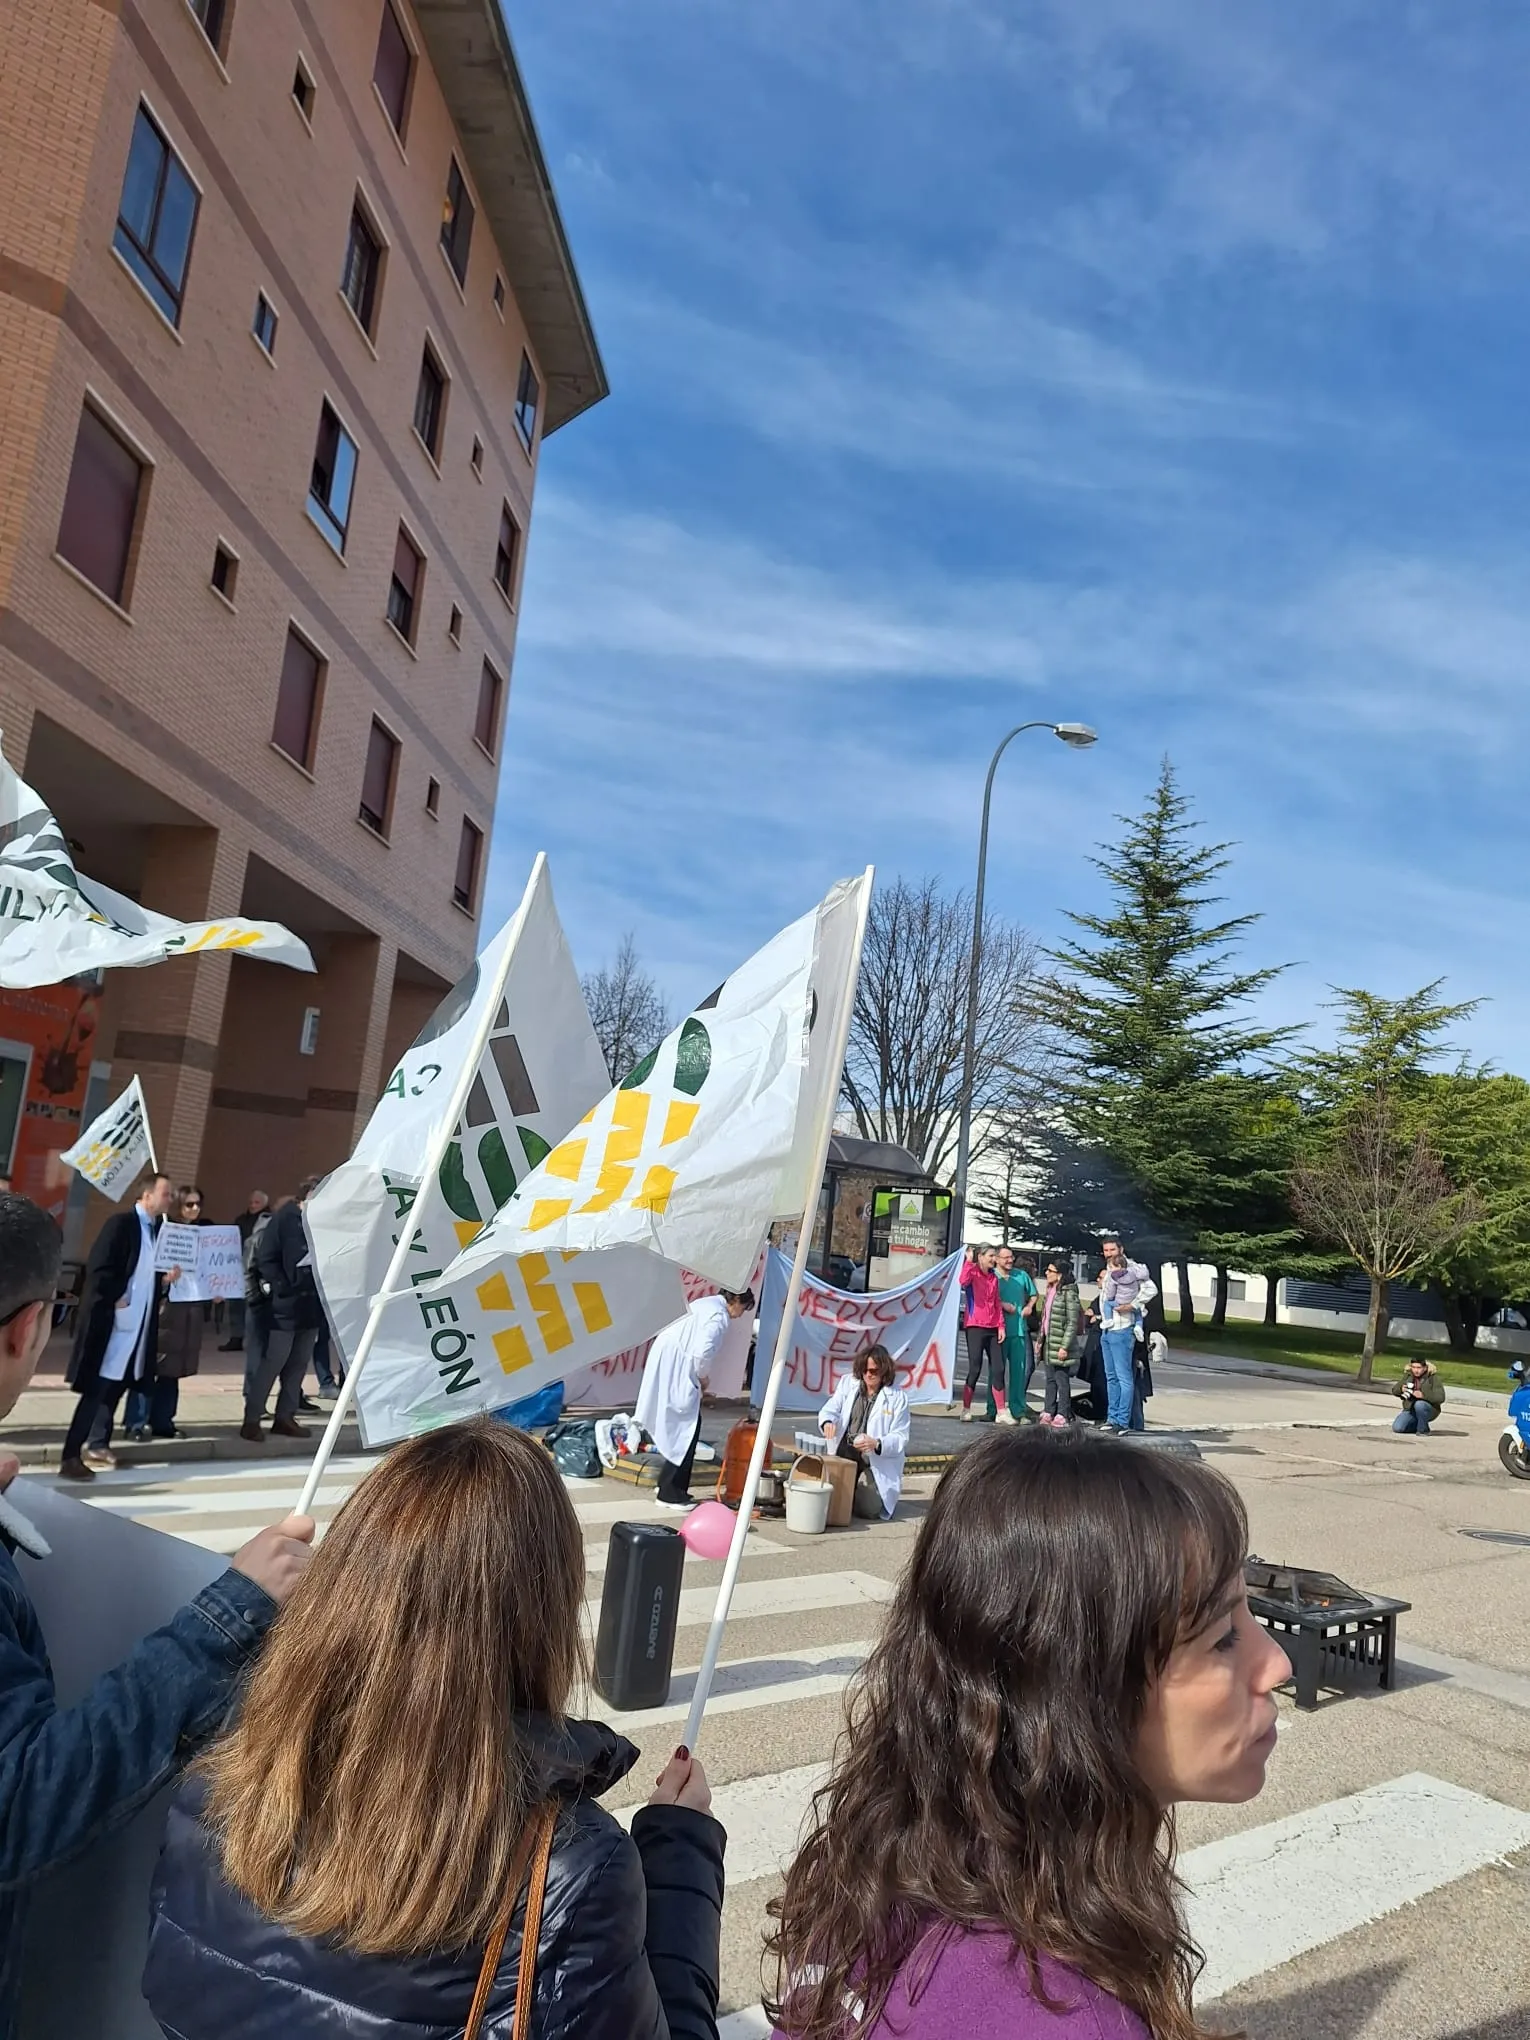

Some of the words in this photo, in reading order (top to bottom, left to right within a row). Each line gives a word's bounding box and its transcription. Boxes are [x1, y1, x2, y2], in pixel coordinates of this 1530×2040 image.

[894, 1234, 903, 1243] tu
[905, 1235, 929, 1248] hogar
[900, 1226, 930, 1236] cambio
[411, 1269, 481, 1395] LEÓN
[829, 1326, 886, 1354] EN
